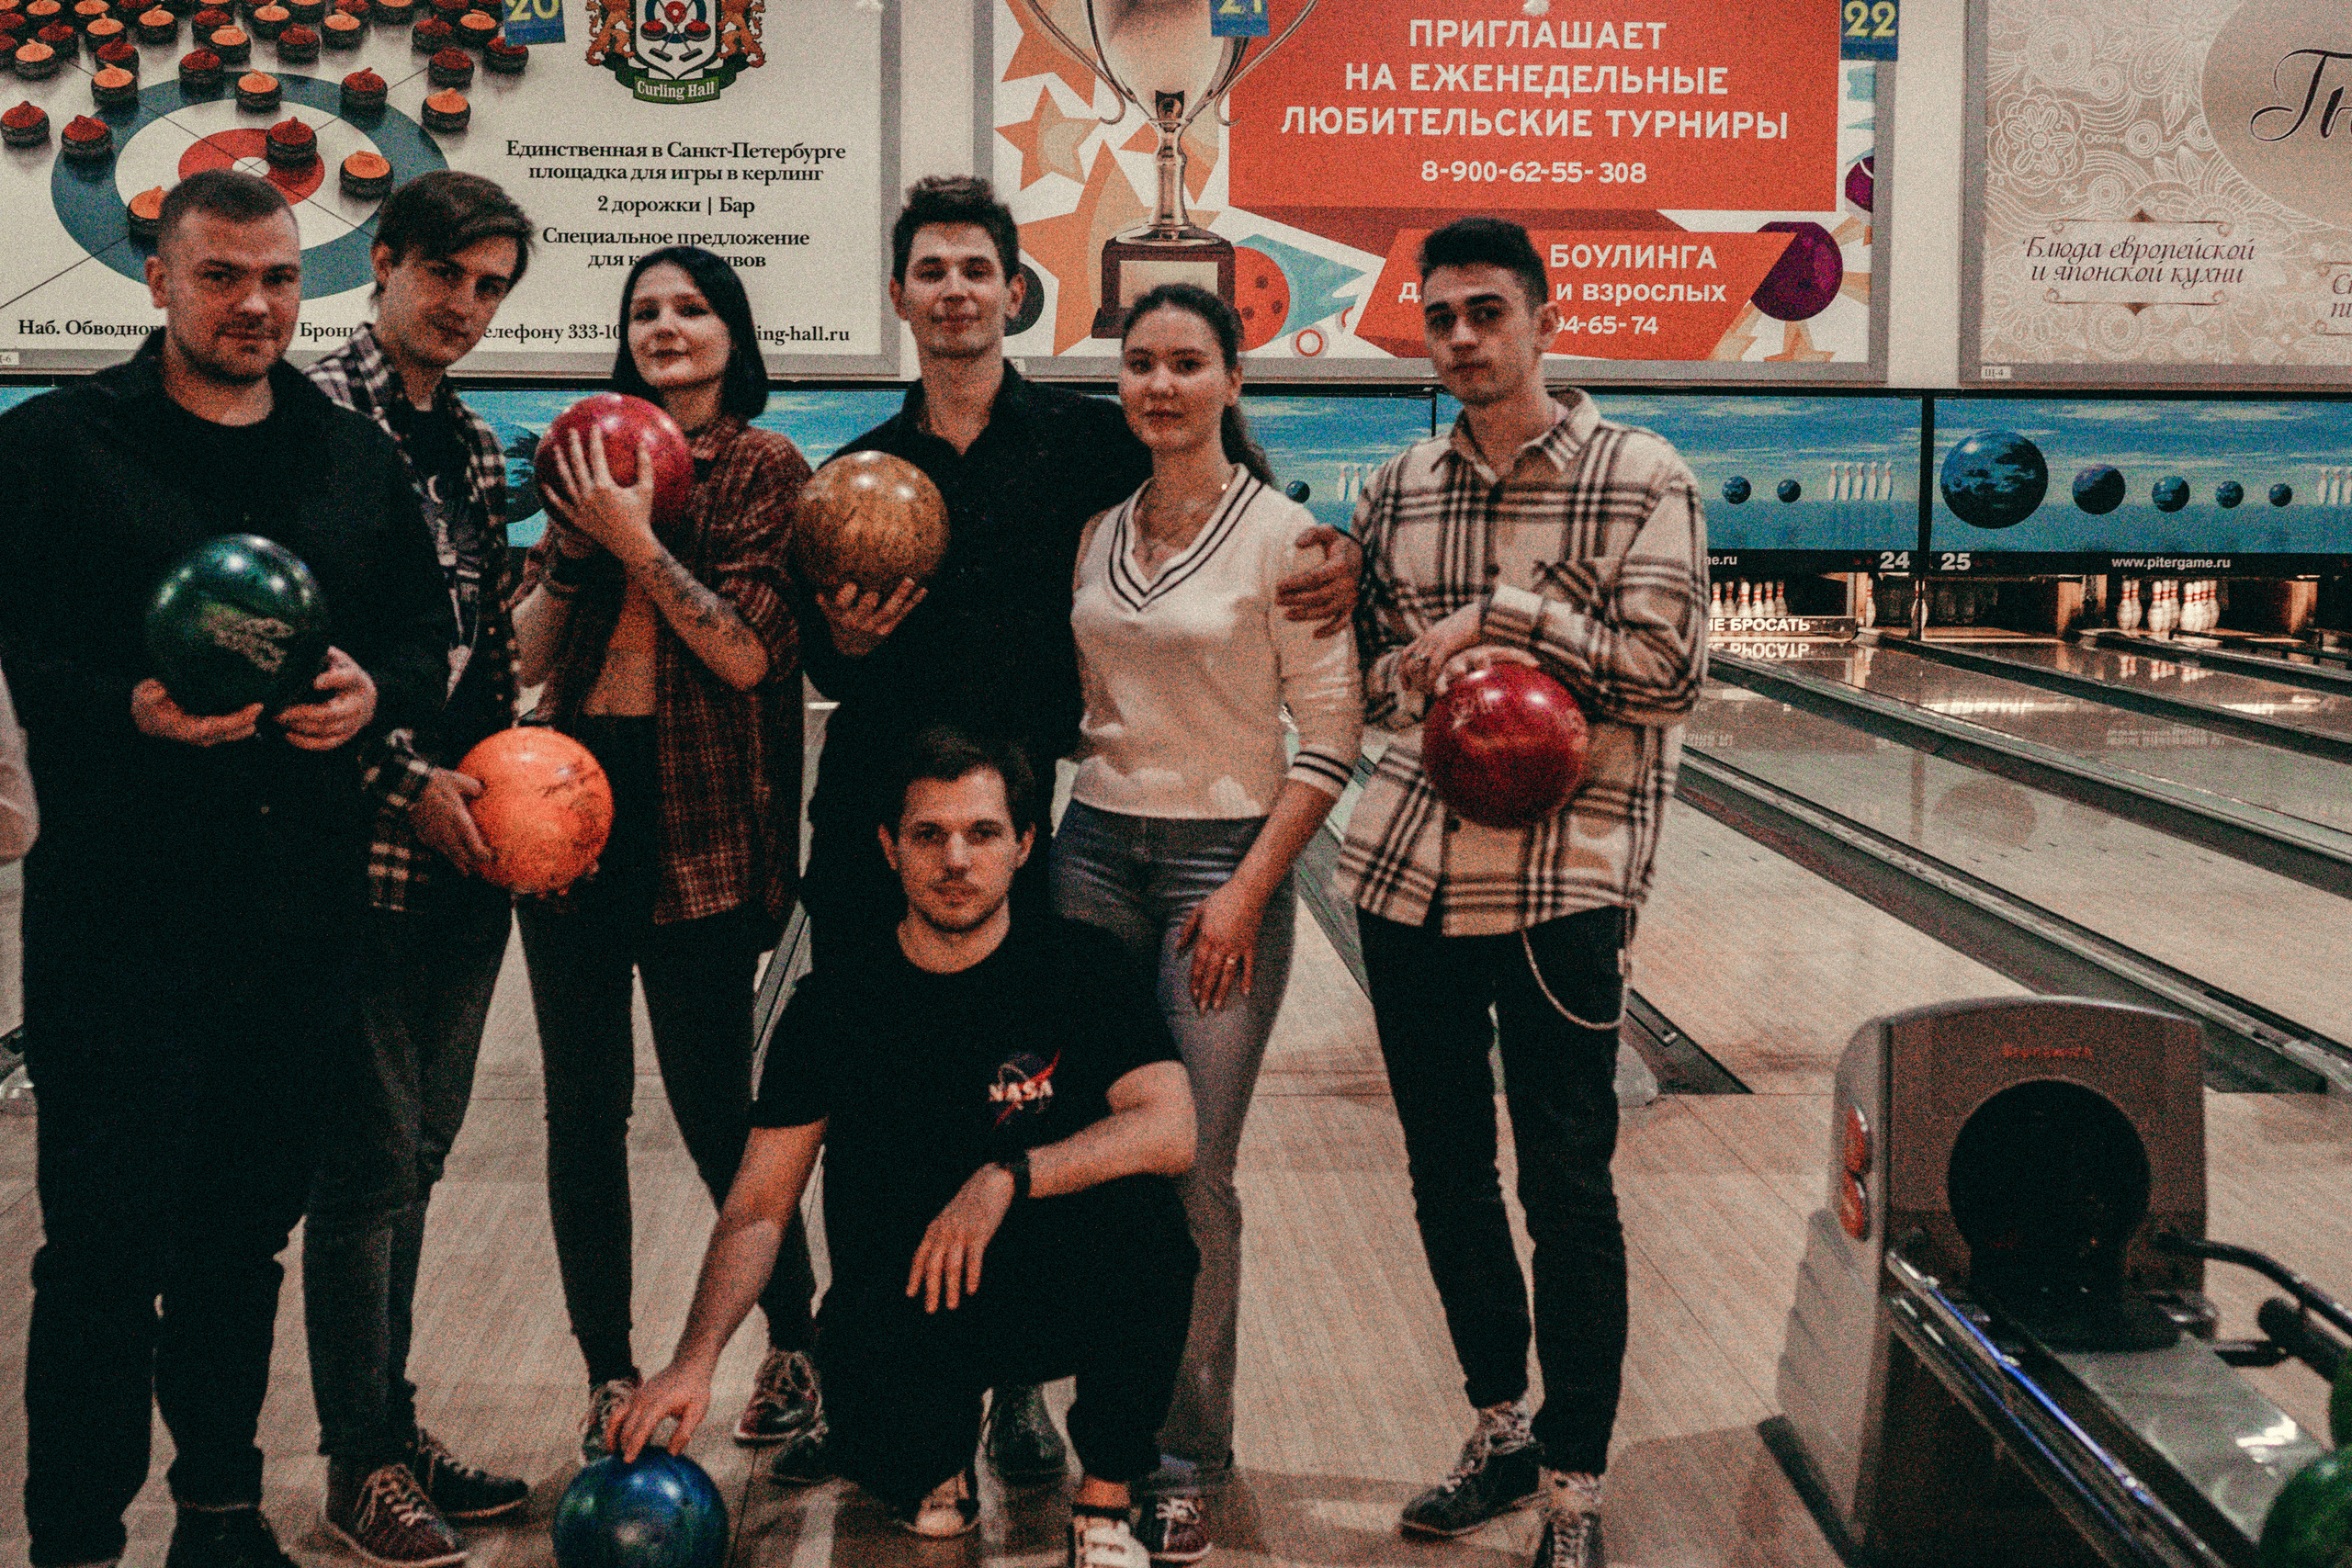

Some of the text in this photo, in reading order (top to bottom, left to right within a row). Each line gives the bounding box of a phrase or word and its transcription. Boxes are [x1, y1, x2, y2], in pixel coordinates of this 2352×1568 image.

[1844, 0, 1896, 38] 22
[1409, 18, 1668, 50] ПРИГЛАШАЕТ
[637, 80, 715, 101] Curling Hall
[1345, 62, 1728, 98] НА ЕЖЕНЕДЕЛЬНЫЕ
[1281, 106, 1788, 139] ЛЮБИТЕЛЬСКИЕ ТУРНИРЫ
[505, 140, 846, 164] Единственная в Санкт-Петербурге
[528, 166, 824, 186] площадка для игры в керлинг
[597, 195, 608, 211] 2
[612, 200, 701, 218] дорожки
[718, 196, 755, 219] Бар
[542, 227, 809, 248] Специальное предложение
[587, 253, 625, 269] для
[1550, 243, 1717, 269] БОУЛИНГА
[2023, 235, 2256, 265] Блюда европейской
[2031, 261, 2244, 290] и японской кухни
[1555, 283, 1727, 307] и взрослых
[17, 319, 61, 336] Наб.
[65, 319, 165, 338] Обводно
[483, 324, 563, 344] елефону
[568, 323, 621, 340] 333-10
[756, 325, 850, 346] ing-hall.ru
[1880, 551, 1910, 569] 24
[1940, 553, 1971, 570] 25
[2111, 557, 2231, 570] www.pitergame.ru
[1730, 618, 1811, 632] БРОСАТЬ
